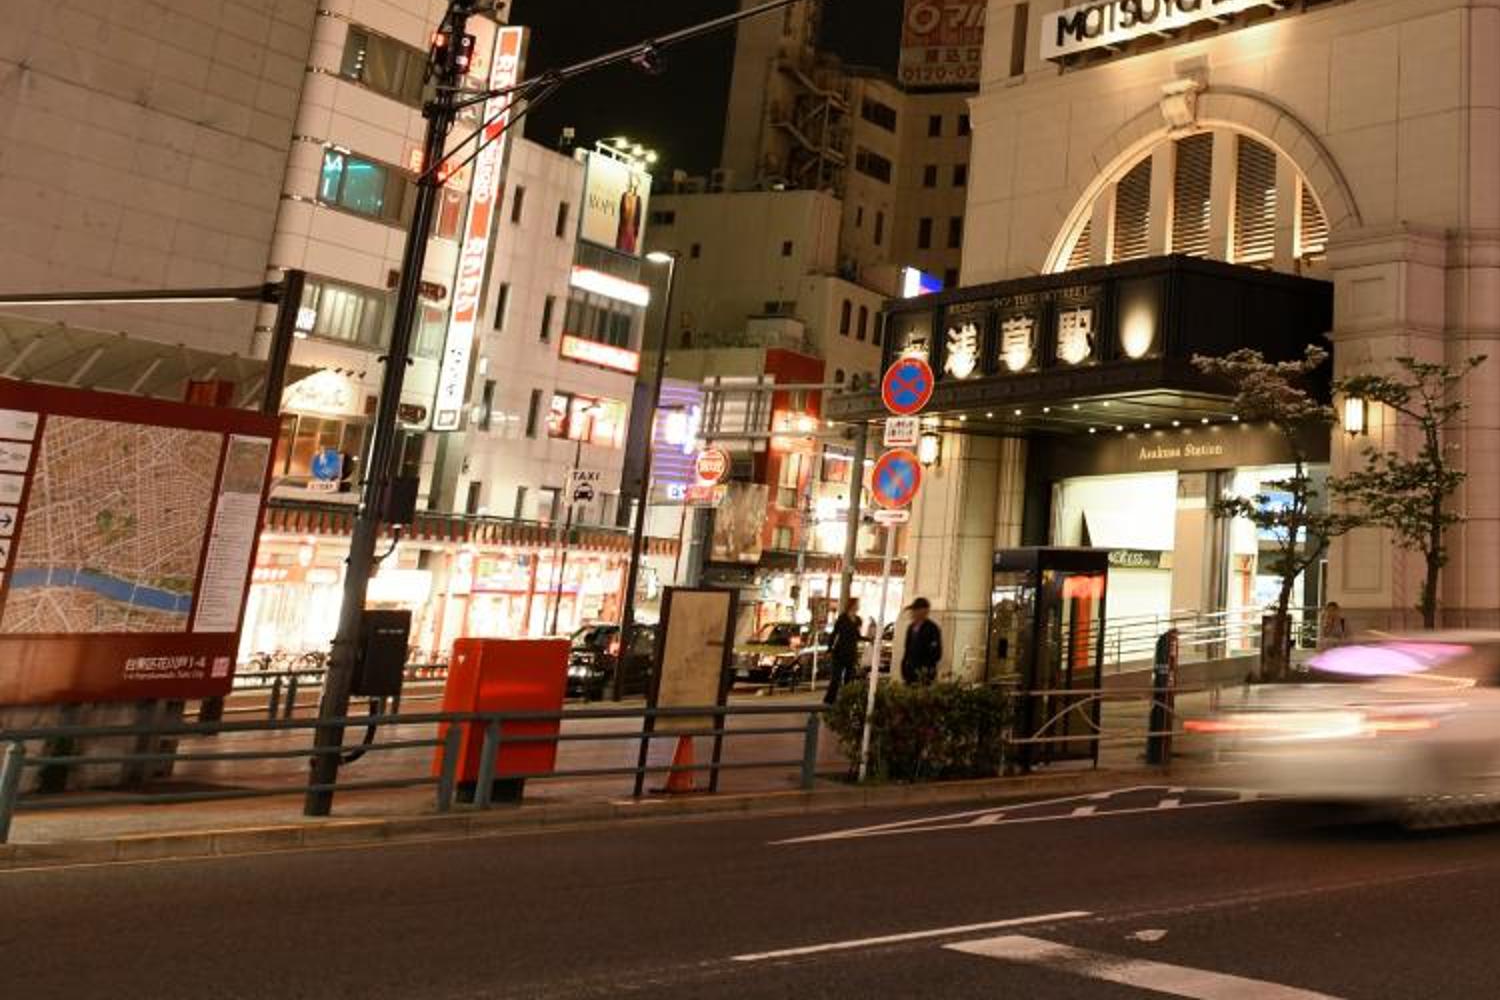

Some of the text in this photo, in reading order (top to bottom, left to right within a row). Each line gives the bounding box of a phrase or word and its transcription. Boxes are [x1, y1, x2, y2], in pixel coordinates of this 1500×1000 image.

[1138, 442, 1223, 460] Asakusa Station
[573, 471, 601, 481] TAXI
